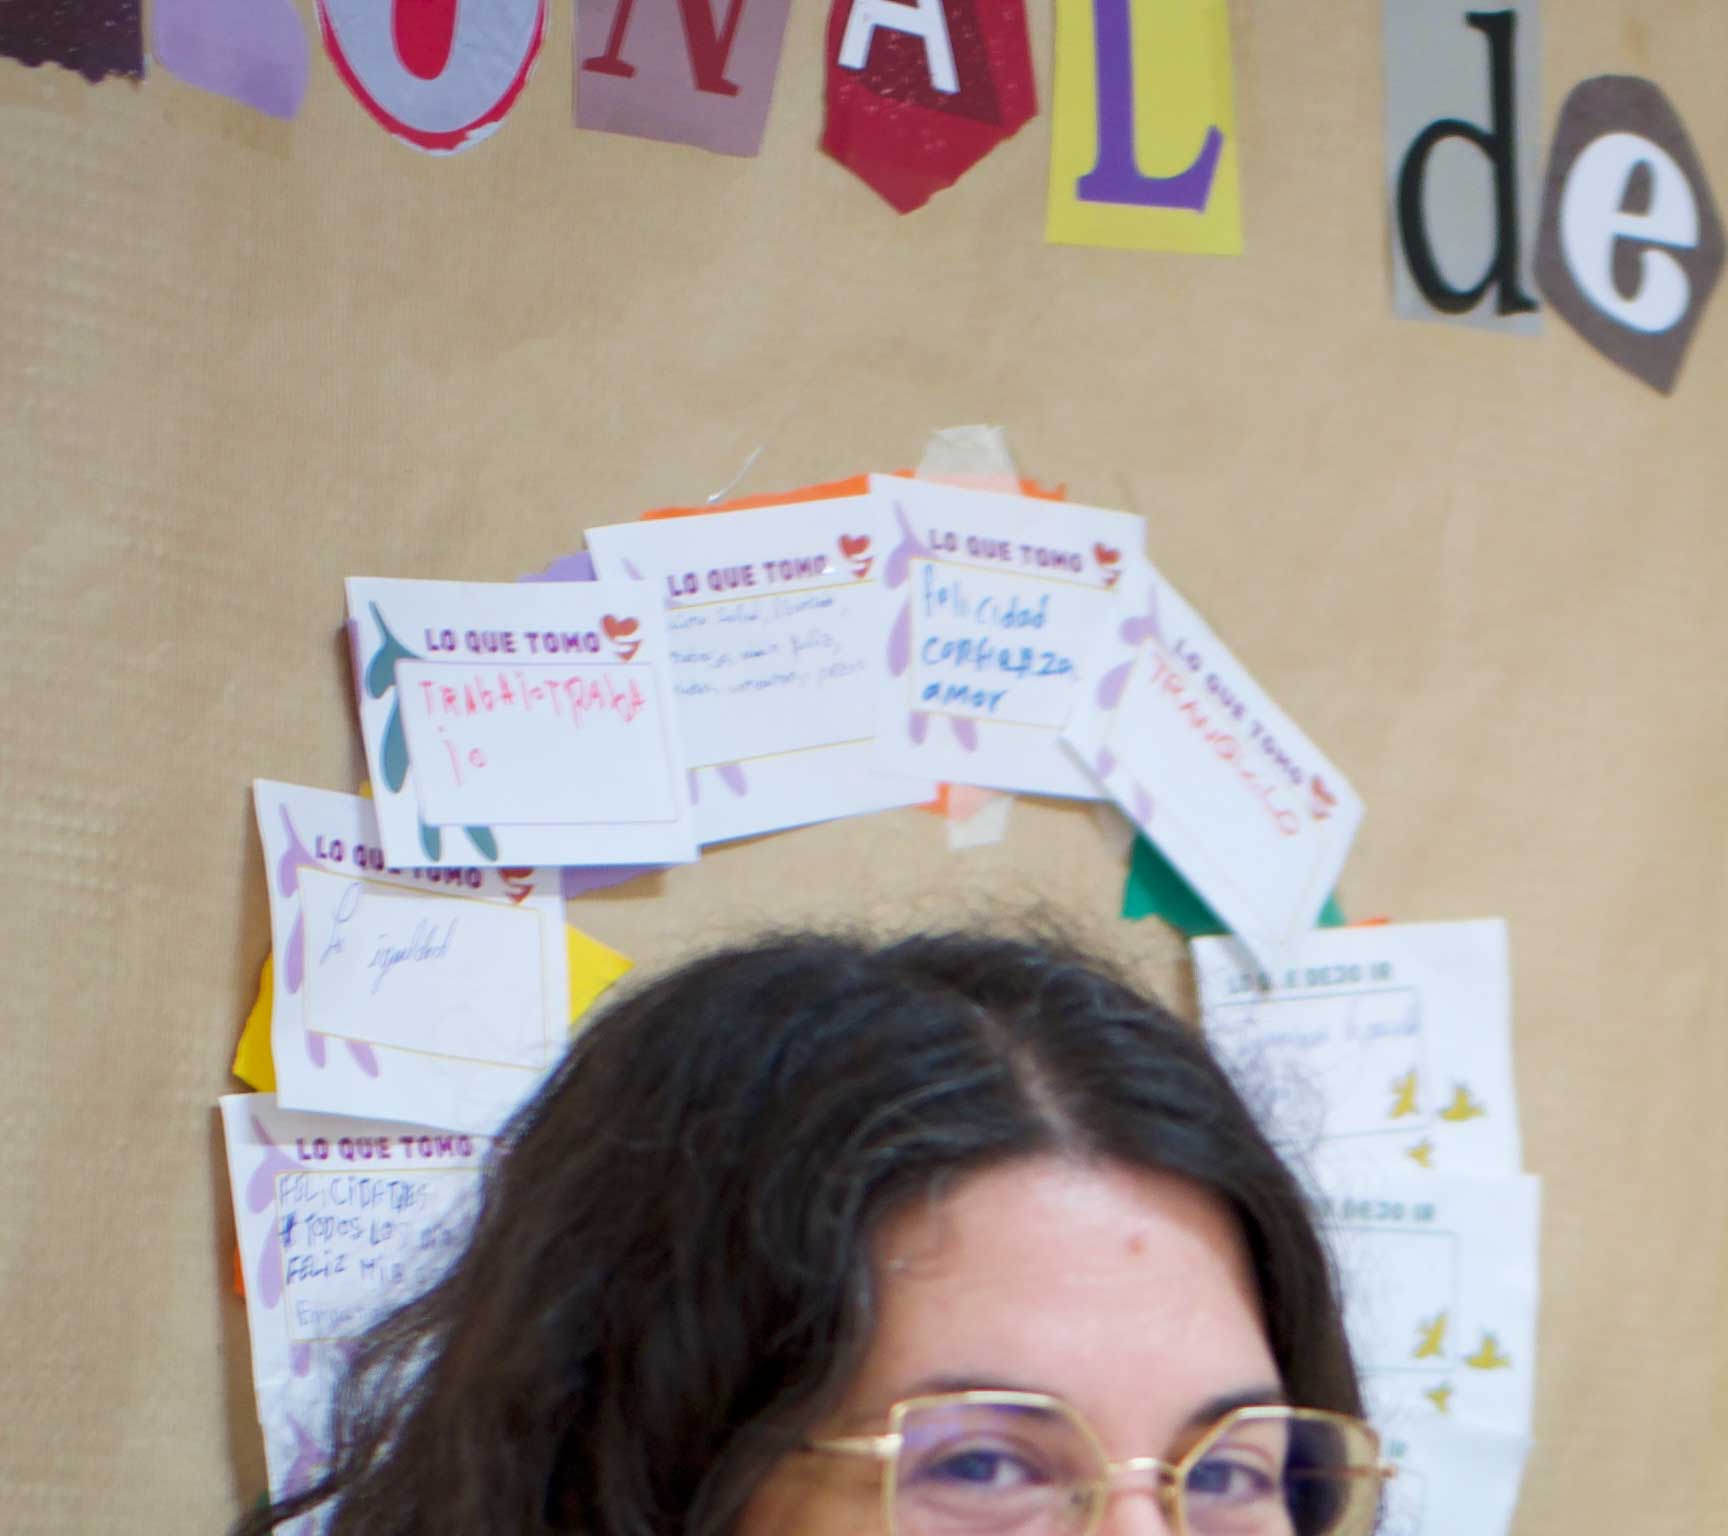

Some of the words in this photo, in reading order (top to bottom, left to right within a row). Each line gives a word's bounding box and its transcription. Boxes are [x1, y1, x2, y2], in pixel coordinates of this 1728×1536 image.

[1399, 8, 1699, 334] de
[929, 529, 958, 552] LO
[966, 536, 1013, 561] QUE
[1018, 544, 1084, 573] TOMO
[667, 574, 699, 597] LO
[706, 563, 757, 592] QUE
[762, 554, 829, 584] TOMO
[424, 628, 456, 652] LO
[464, 629, 517, 654] QUE
[524, 631, 600, 654] TOMO
[316, 835, 345, 862] LO
[352, 843, 402, 876] QU
[297, 1137, 329, 1160] LO
[338, 1137, 391, 1161] QUE
[399, 1135, 473, 1159] TOMO
